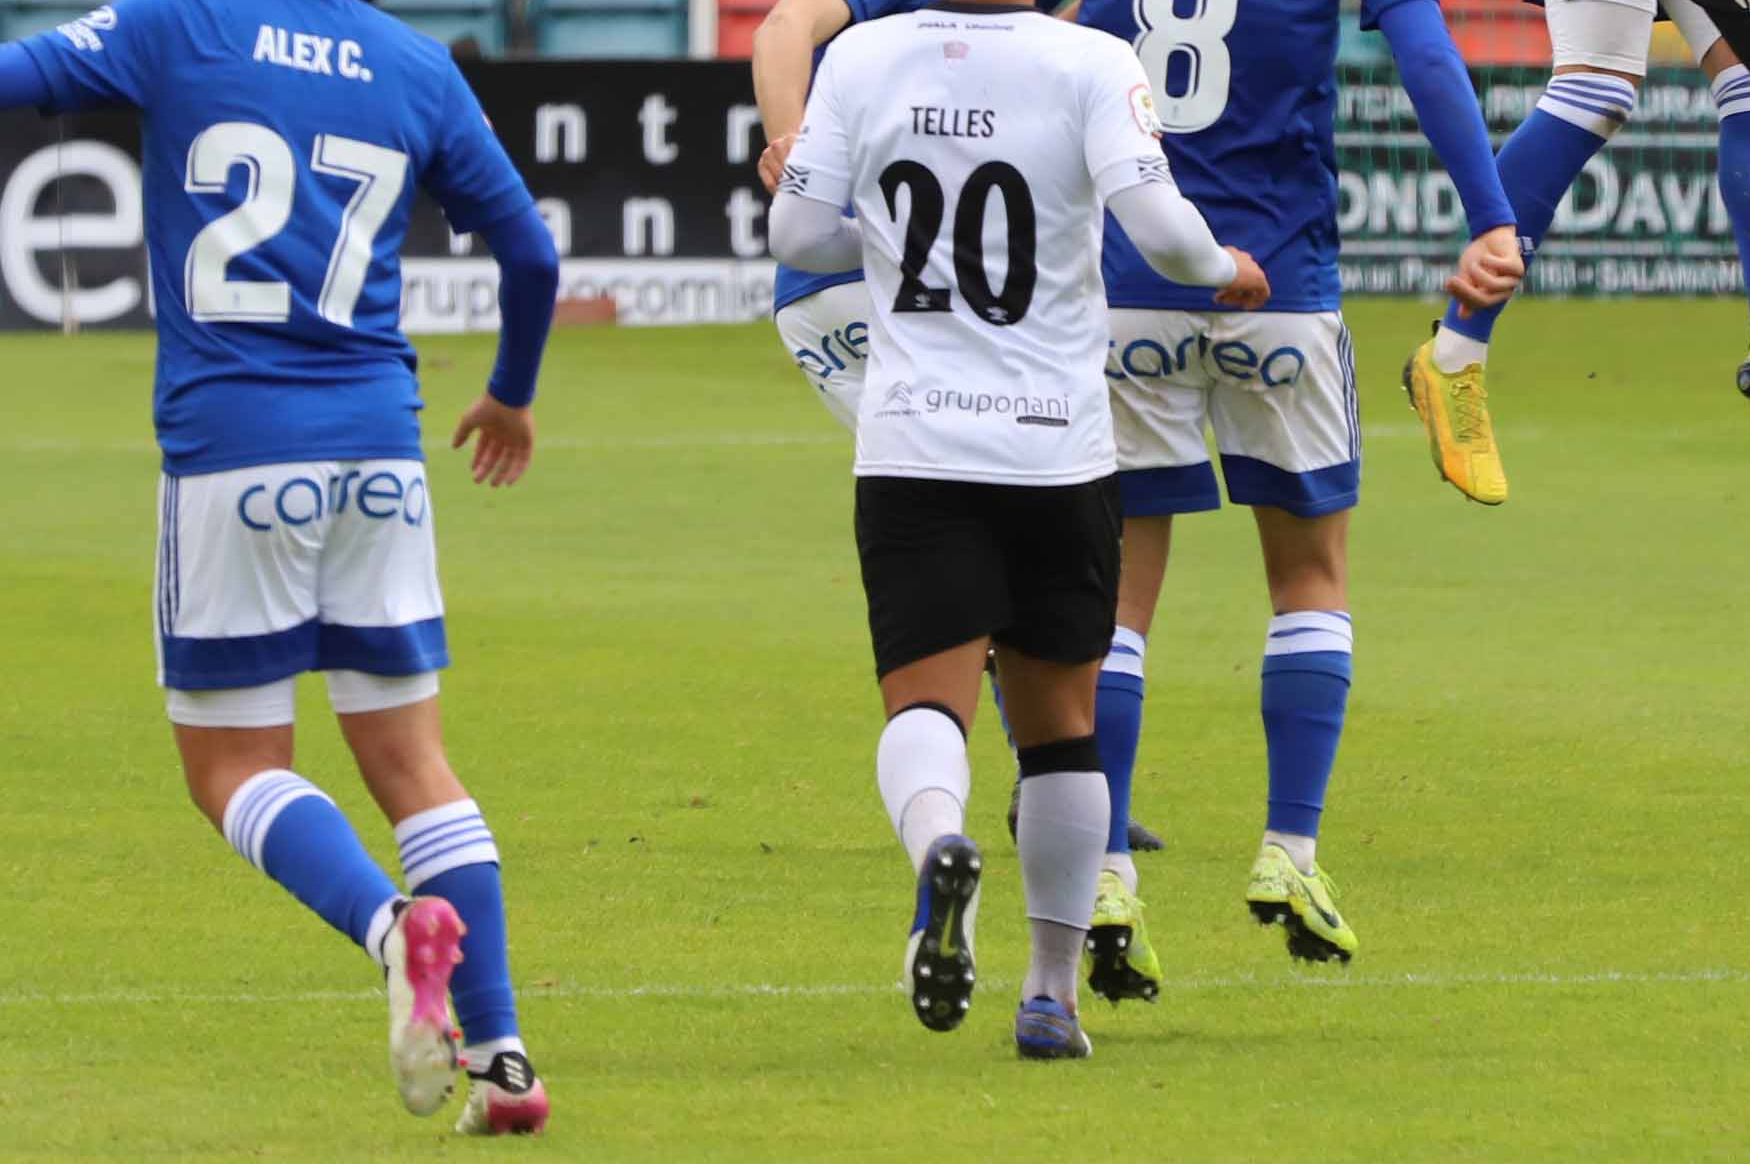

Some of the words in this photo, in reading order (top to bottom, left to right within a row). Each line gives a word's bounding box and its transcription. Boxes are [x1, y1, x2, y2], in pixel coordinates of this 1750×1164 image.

[253, 25, 333, 76] ALEX
[337, 39, 374, 82] C.
[911, 107, 996, 138] TELLES
[185, 122, 408, 328] 27
[879, 160, 1037, 326] 20
[926, 388, 1070, 417] gruponani
